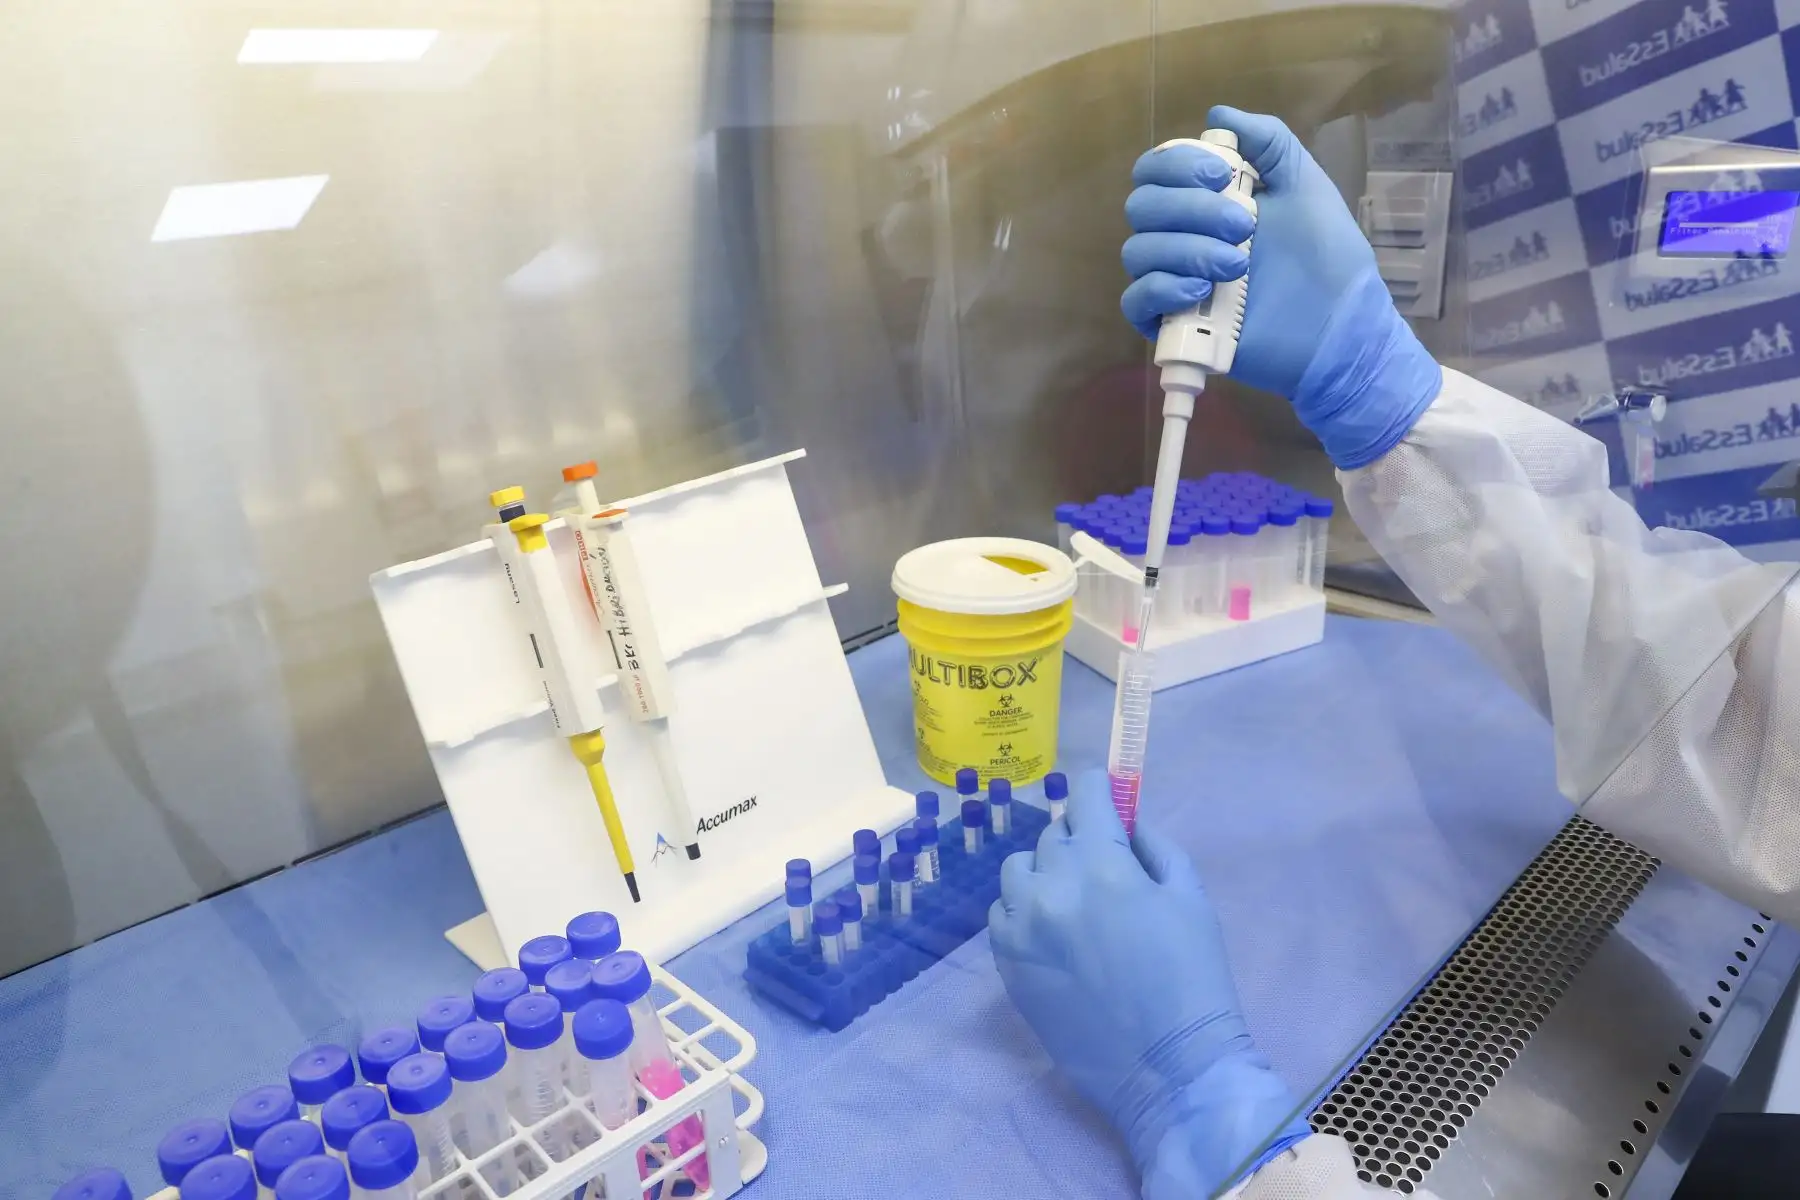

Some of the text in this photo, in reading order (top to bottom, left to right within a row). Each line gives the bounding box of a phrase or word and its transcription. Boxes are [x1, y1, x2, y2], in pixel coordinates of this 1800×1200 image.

[989, 706, 1023, 717] DANGER
[990, 755, 1021, 766] PERICOL
[696, 794, 758, 834] Accumax
